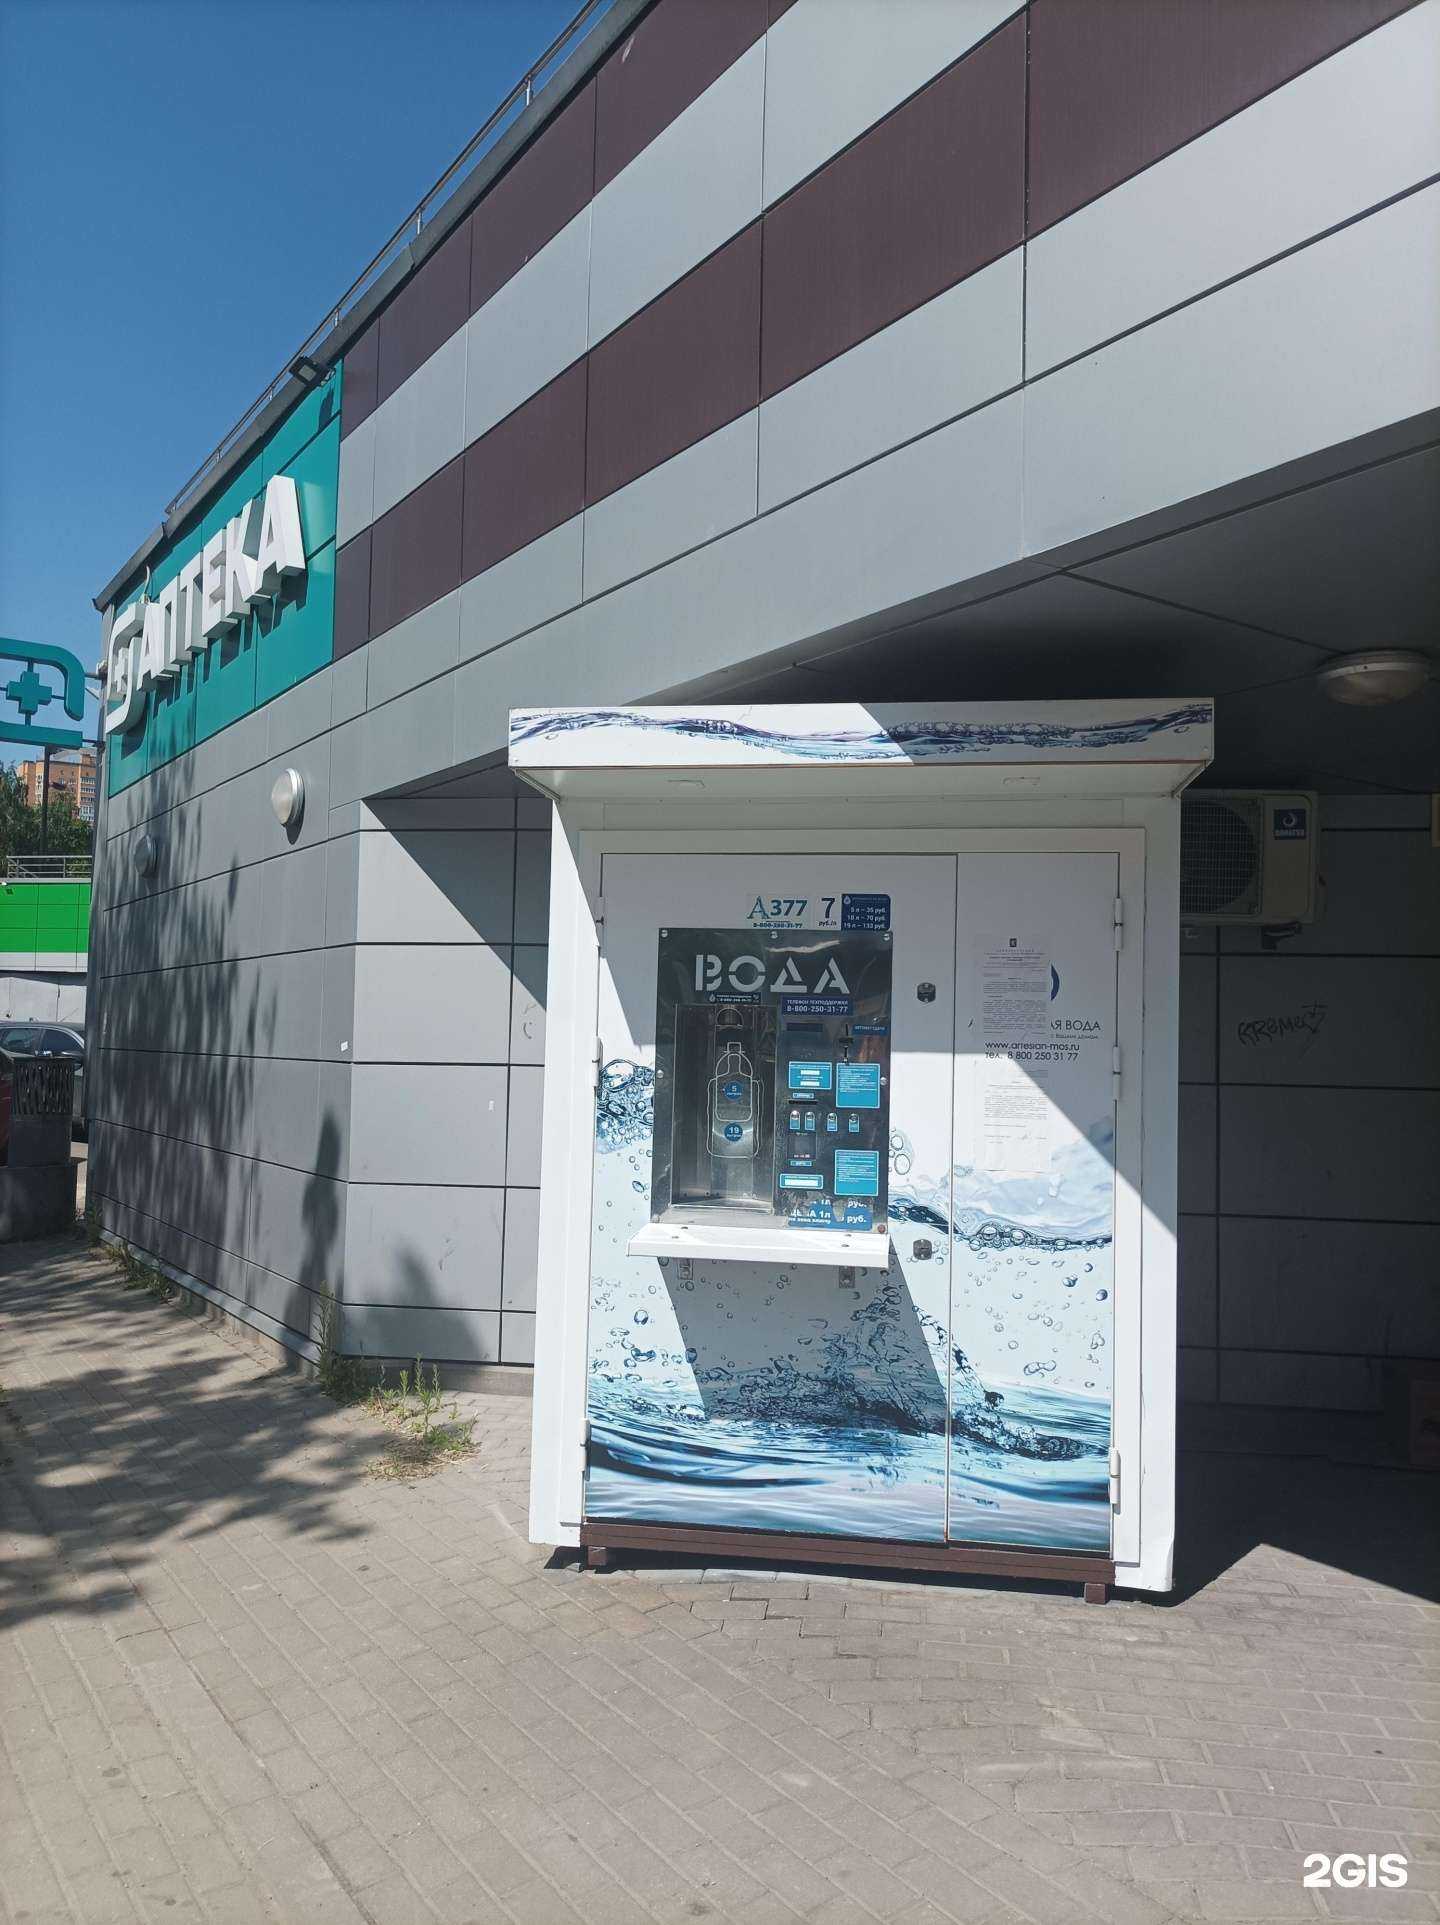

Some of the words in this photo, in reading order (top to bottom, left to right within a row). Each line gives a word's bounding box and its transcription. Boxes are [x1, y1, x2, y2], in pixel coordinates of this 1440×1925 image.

[136, 475, 306, 691] АПТЕКА
[821, 897, 836, 918] 7
[695, 954, 850, 994] ВОДА
[786, 1005, 849, 1013] 8-800-250-31-77
[1065, 1019, 1101, 1032] ВОДА
[985, 1050, 1003, 1059] тел.
[1007, 1051, 1013, 1059] 8
[1015, 1051, 1032, 1060] 800
[1035, 1051, 1051, 1060] 250
[1053, 1052, 1063, 1060] 31
[1067, 1052, 1079, 1061] 77
[729, 1126, 740, 1134] 19
[818, 1209, 831, 1218] 1л
[847, 1214, 867, 1224] руб.
